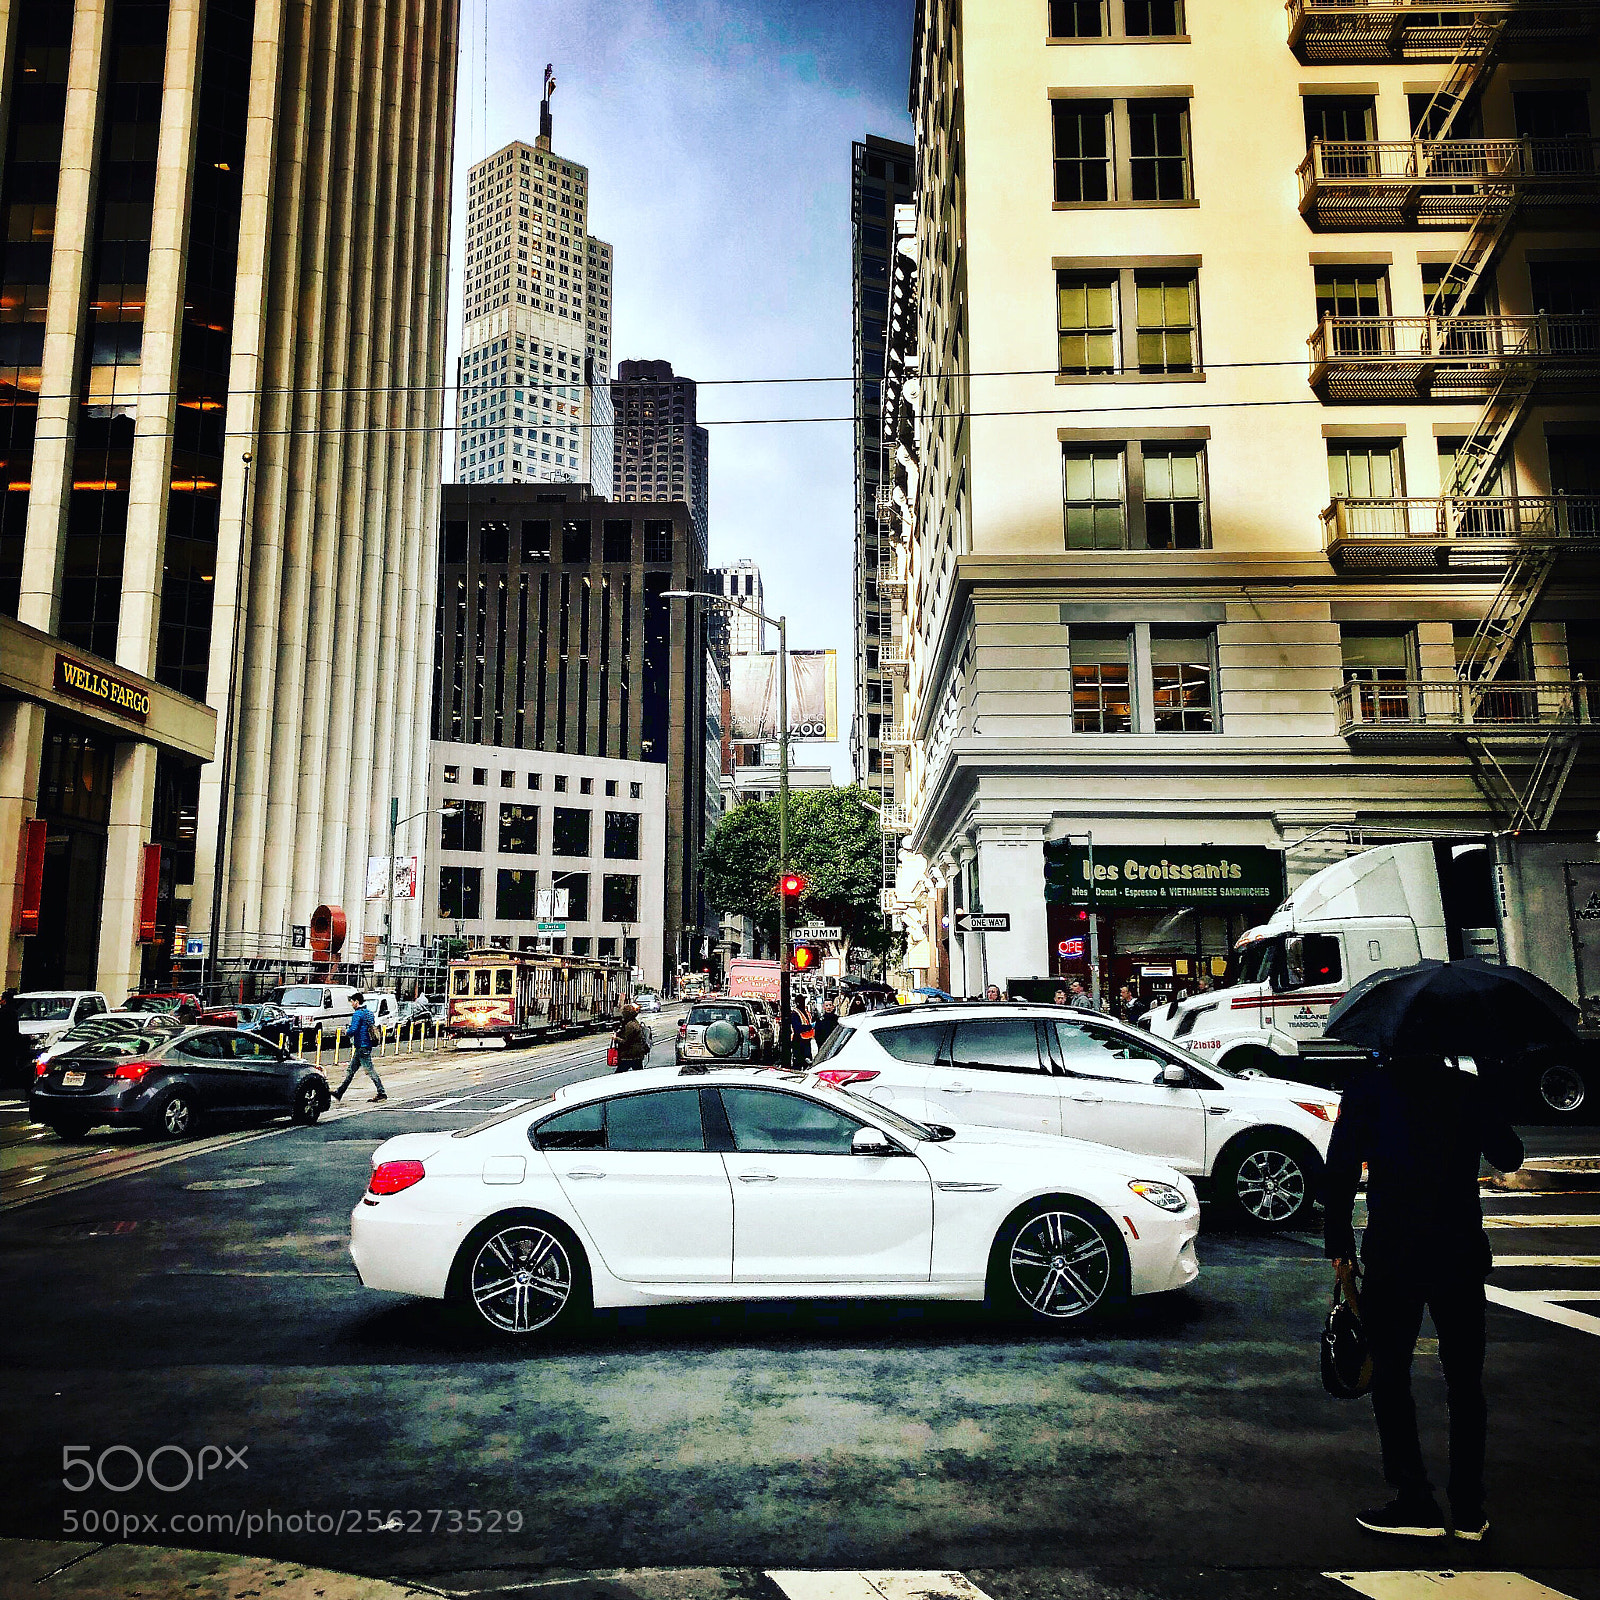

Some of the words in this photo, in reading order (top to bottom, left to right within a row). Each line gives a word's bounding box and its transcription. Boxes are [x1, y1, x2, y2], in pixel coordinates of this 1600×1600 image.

[63, 662, 109, 698] WELLS
[110, 682, 150, 714] FARGO
[790, 723, 826, 736] ZOO
[1124, 860, 1242, 880] Croissants
[1095, 888, 1117, 897] Donut
[1124, 887, 1158, 898] Espresso
[1169, 887, 1218, 897] VIETNAMESE
[1219, 887, 1270, 897] SANDWICHES
[971, 919, 986, 927] ONE
[988, 918, 1004, 927] WAY
[795, 929, 838, 938] DRUMM
[1058, 941, 1083, 953] OPE
